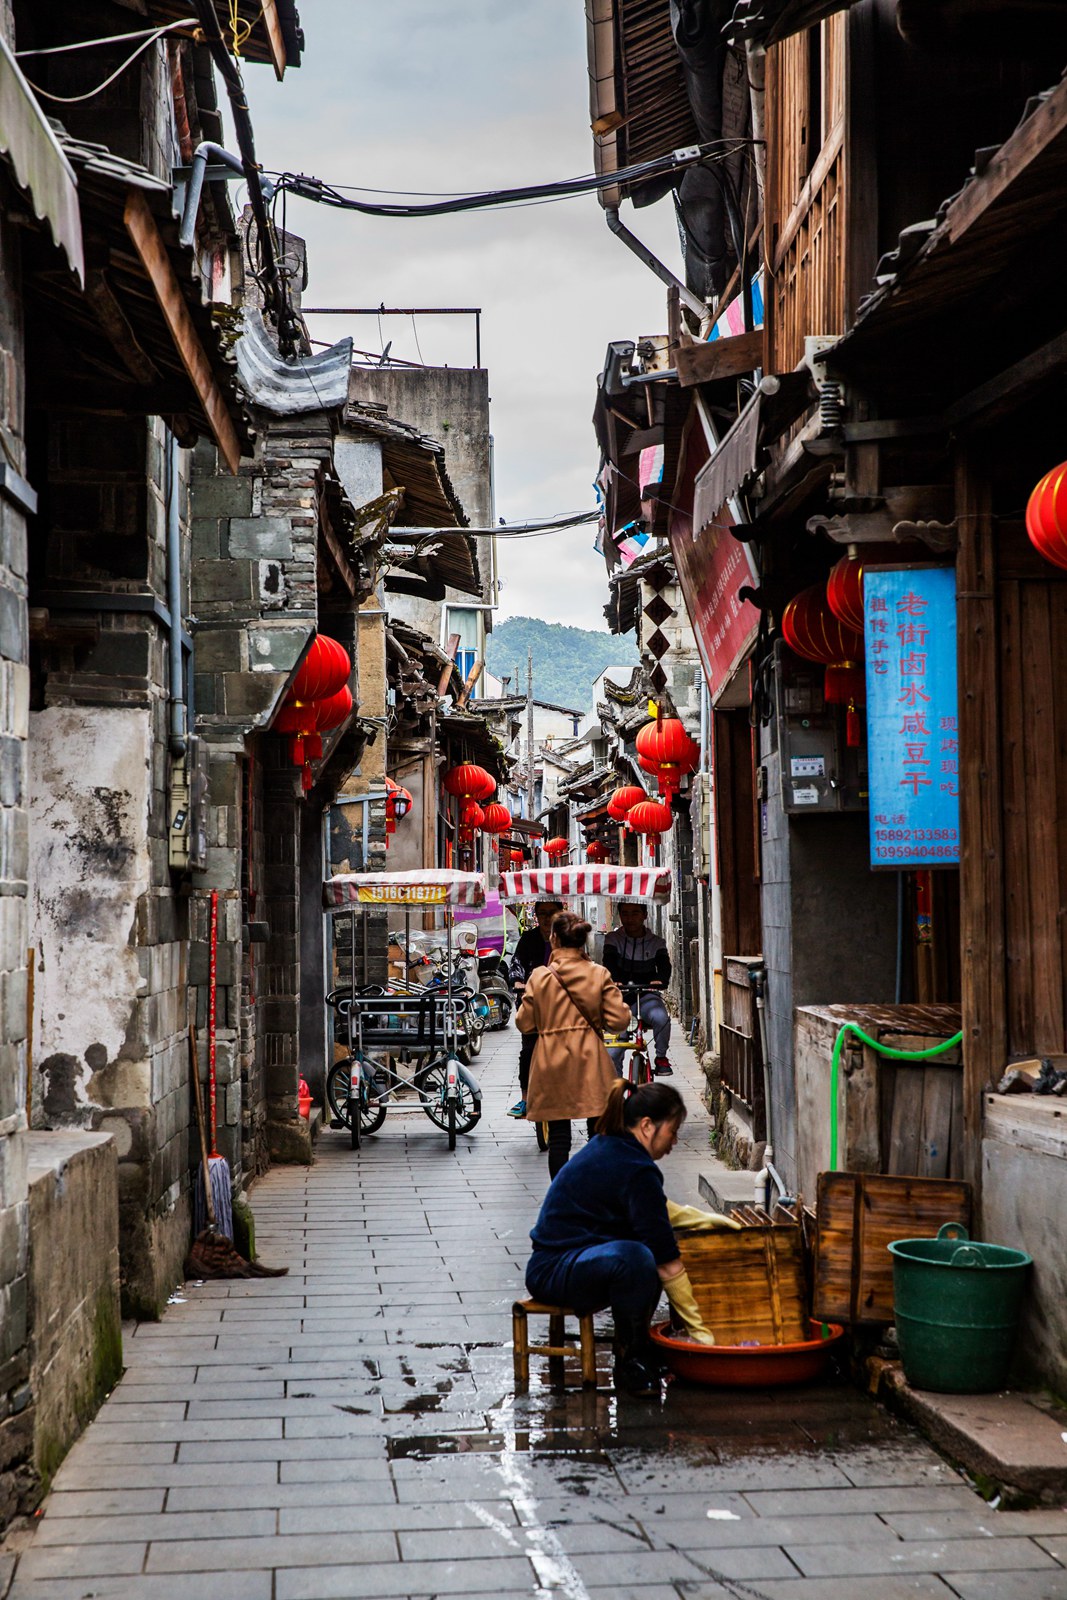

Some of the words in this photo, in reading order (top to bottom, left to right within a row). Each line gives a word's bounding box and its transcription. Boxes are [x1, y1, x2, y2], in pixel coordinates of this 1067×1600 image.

[870, 597, 889, 675] 祖传手艺
[896, 591, 933, 796] 老街卤水咸豆干
[940, 716, 960, 797] 现烤现吃
[874, 814, 907, 825] 电话
[875, 829, 957, 841] 15892133583
[875, 845, 960, 858] 13959404865
